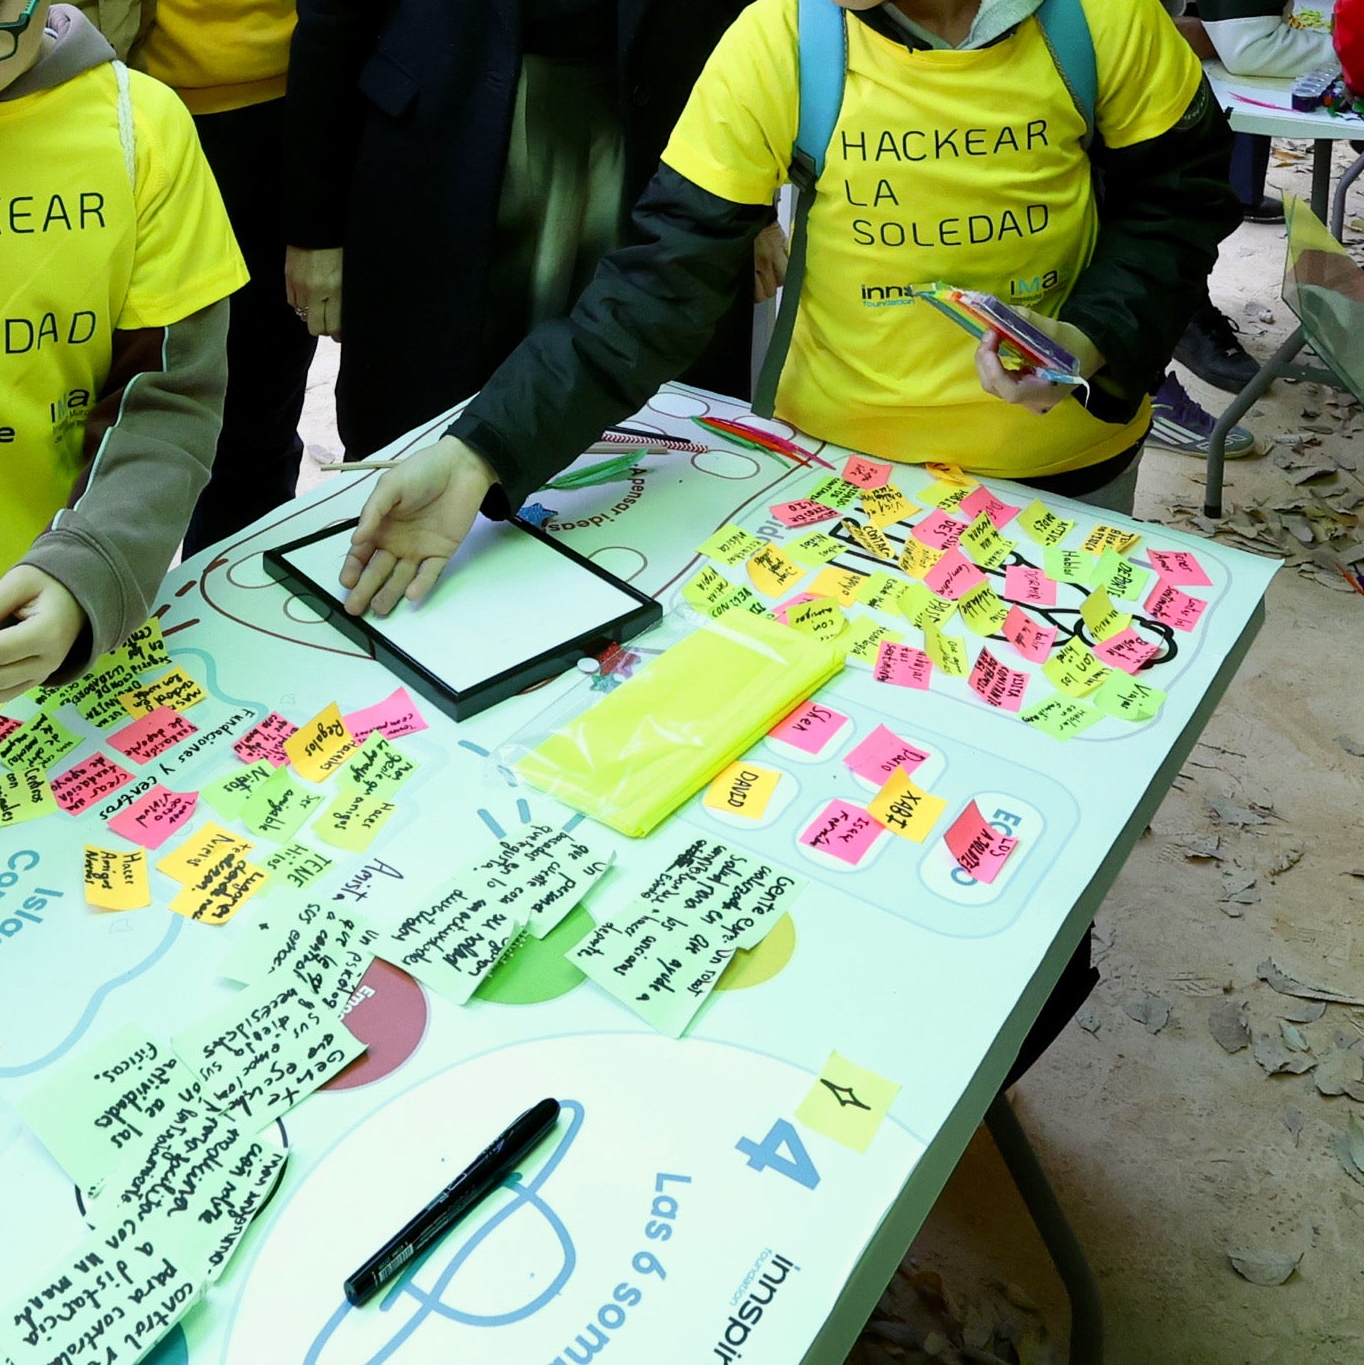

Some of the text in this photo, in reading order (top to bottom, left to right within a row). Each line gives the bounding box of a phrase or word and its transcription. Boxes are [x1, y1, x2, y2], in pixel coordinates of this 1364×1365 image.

[841, 119, 1048, 162] HACKEAR
[844, 179, 899, 207] LA
[853, 204, 1050, 248] SOLEDAD
[735, 1118, 821, 1190] 4
[632, 1173, 692, 1280] Las 6
